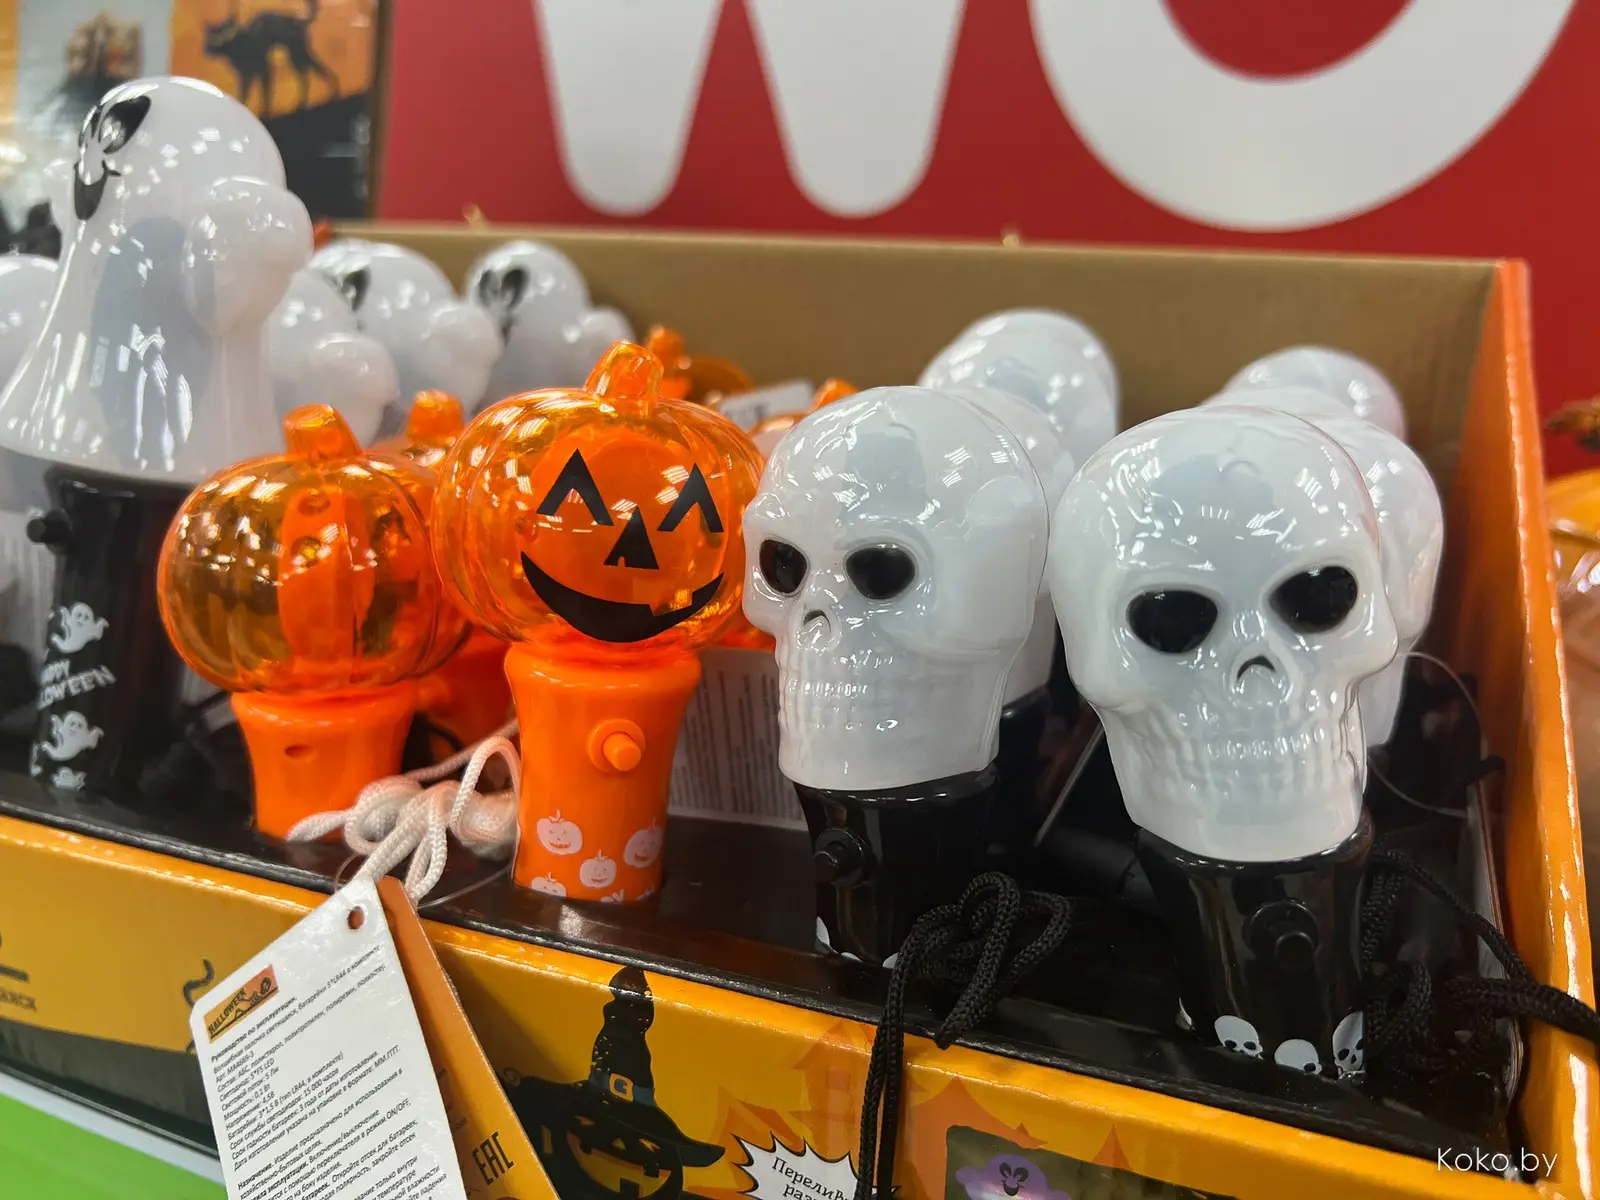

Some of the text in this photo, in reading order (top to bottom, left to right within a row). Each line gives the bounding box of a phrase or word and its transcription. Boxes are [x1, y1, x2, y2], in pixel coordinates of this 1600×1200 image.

[211, 1033, 247, 1063] Руководство
[247, 1027, 256, 1035] по
[263, 1057, 275, 1070] LED
[312, 1052, 343, 1079] комплекте)
[230, 1137, 244, 1150] Срок
[244, 1121, 266, 1140] службы
[303, 1086, 311, 1097] 15
[311, 1078, 323, 1091] 000
[322, 1068, 339, 1082] часов
[232, 1147, 246, 1160] Срок
[246, 1129, 271, 1150] годности
[304, 1095, 317, 1108] года
[317, 1089, 324, 1098] от
[325, 1079, 339, 1095] даты
[339, 1051, 378, 1082] изготовления.
[254, 1088, 264, 1099] 0,1
[263, 1083, 270, 1093] Вт
[234, 1157, 248, 1172] Дата
[248, 1129, 285, 1160] изготовления
[285, 1114, 308, 1134] указана
[308, 1108, 316, 1117] на
[316, 1089, 342, 1112] упаковке
[347, 1065, 373, 1089] формате:
[237, 1163, 274, 1190] Назначение.
[274, 1144, 299, 1165] Изделие
[299, 1112, 343, 1147] предназначено
[343, 1103, 354, 1117] для
[355, 1071, 398, 1106] использования
[267, 1109, 379, 1193] эксплуатации. Включение/выключение
[287, 1167, 316, 1190] помощью
[316, 1135, 360, 1170] переключателя
[365, 1116, 386, 1136] режим
[301, 1182, 330, 1200] тареек.
[332, 1160, 360, 1183] Откройте
[360, 1148, 377, 1163] отсек
[377, 1139, 388, 1153] для
[388, 1120, 418, 1142] батареек,
[304, 1139, 323, 1155] целях.
[335, 1166, 371, 1193] полярность,
[371, 1144, 398, 1167] закройте
[399, 1132, 416, 1147] отсек
[294, 1189, 301, 1198] на
[301, 1179, 315, 1193] боку
[316, 1161, 342, 1182] изделия.
[375, 1156, 418, 1189] только внутри
[377, 1169, 416, 1200] температуре
[407, 1165, 439, 1192] влажности
[772, 1156, 849, 1200] Перелив
